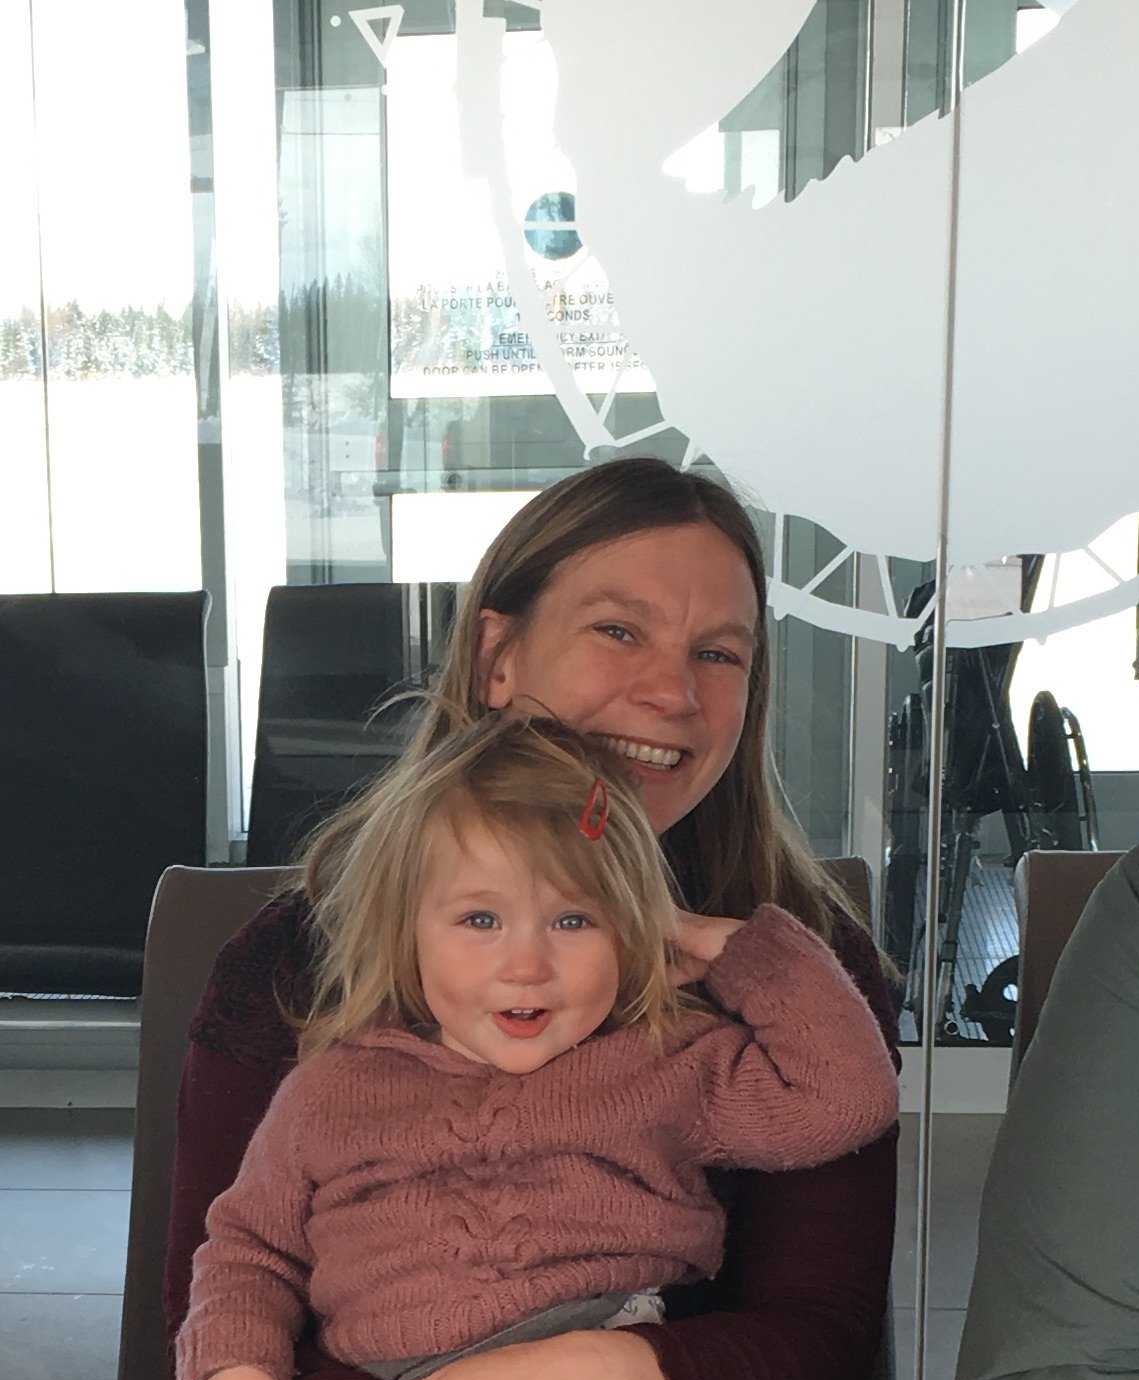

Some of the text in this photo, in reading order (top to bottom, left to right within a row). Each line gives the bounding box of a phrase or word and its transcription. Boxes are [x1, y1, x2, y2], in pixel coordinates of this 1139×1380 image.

[442, 297, 482, 309] PORTE
[547, 310, 590, 321] CONDS
[466, 349, 498, 361] PUSH
[502, 346, 536, 360] UNTIL
